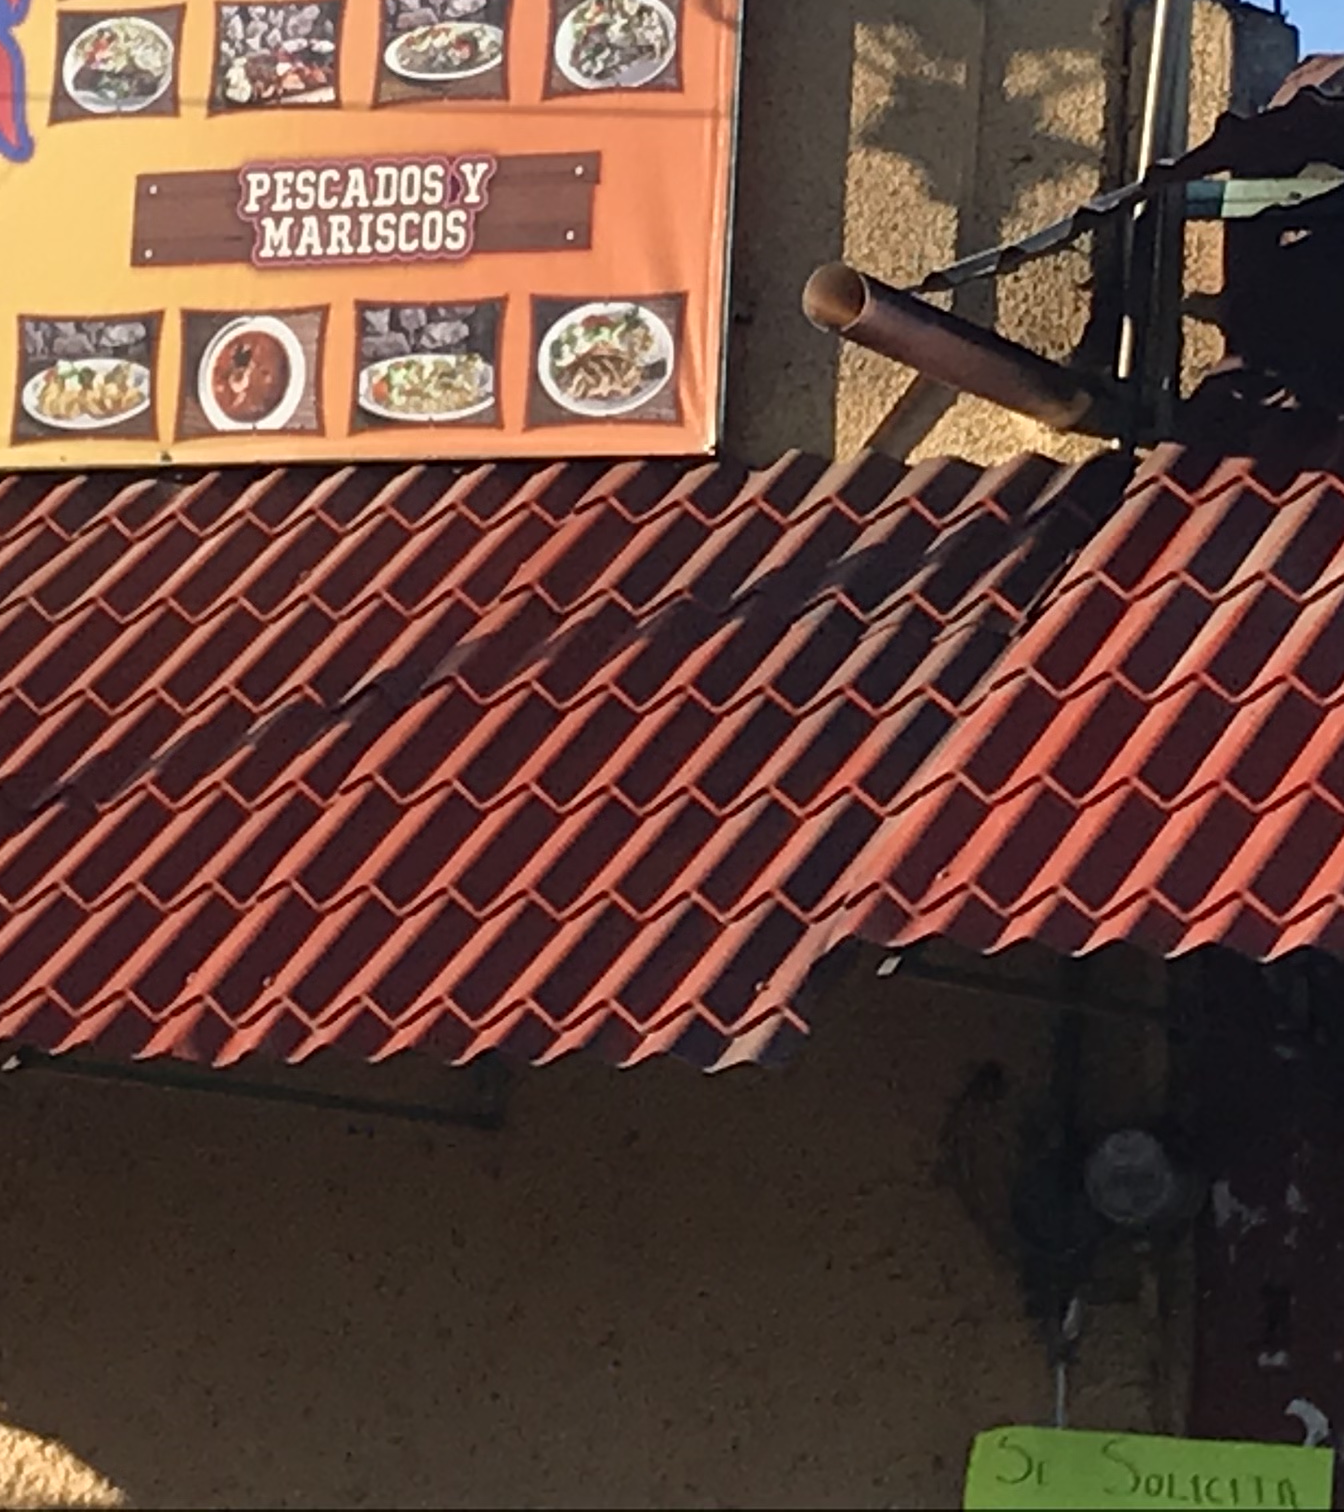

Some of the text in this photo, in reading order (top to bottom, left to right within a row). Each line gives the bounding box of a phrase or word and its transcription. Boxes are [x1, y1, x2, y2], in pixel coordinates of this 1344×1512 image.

[244, 161, 490, 214] PESCADOS Y
[257, 210, 467, 259] MARISCOS
